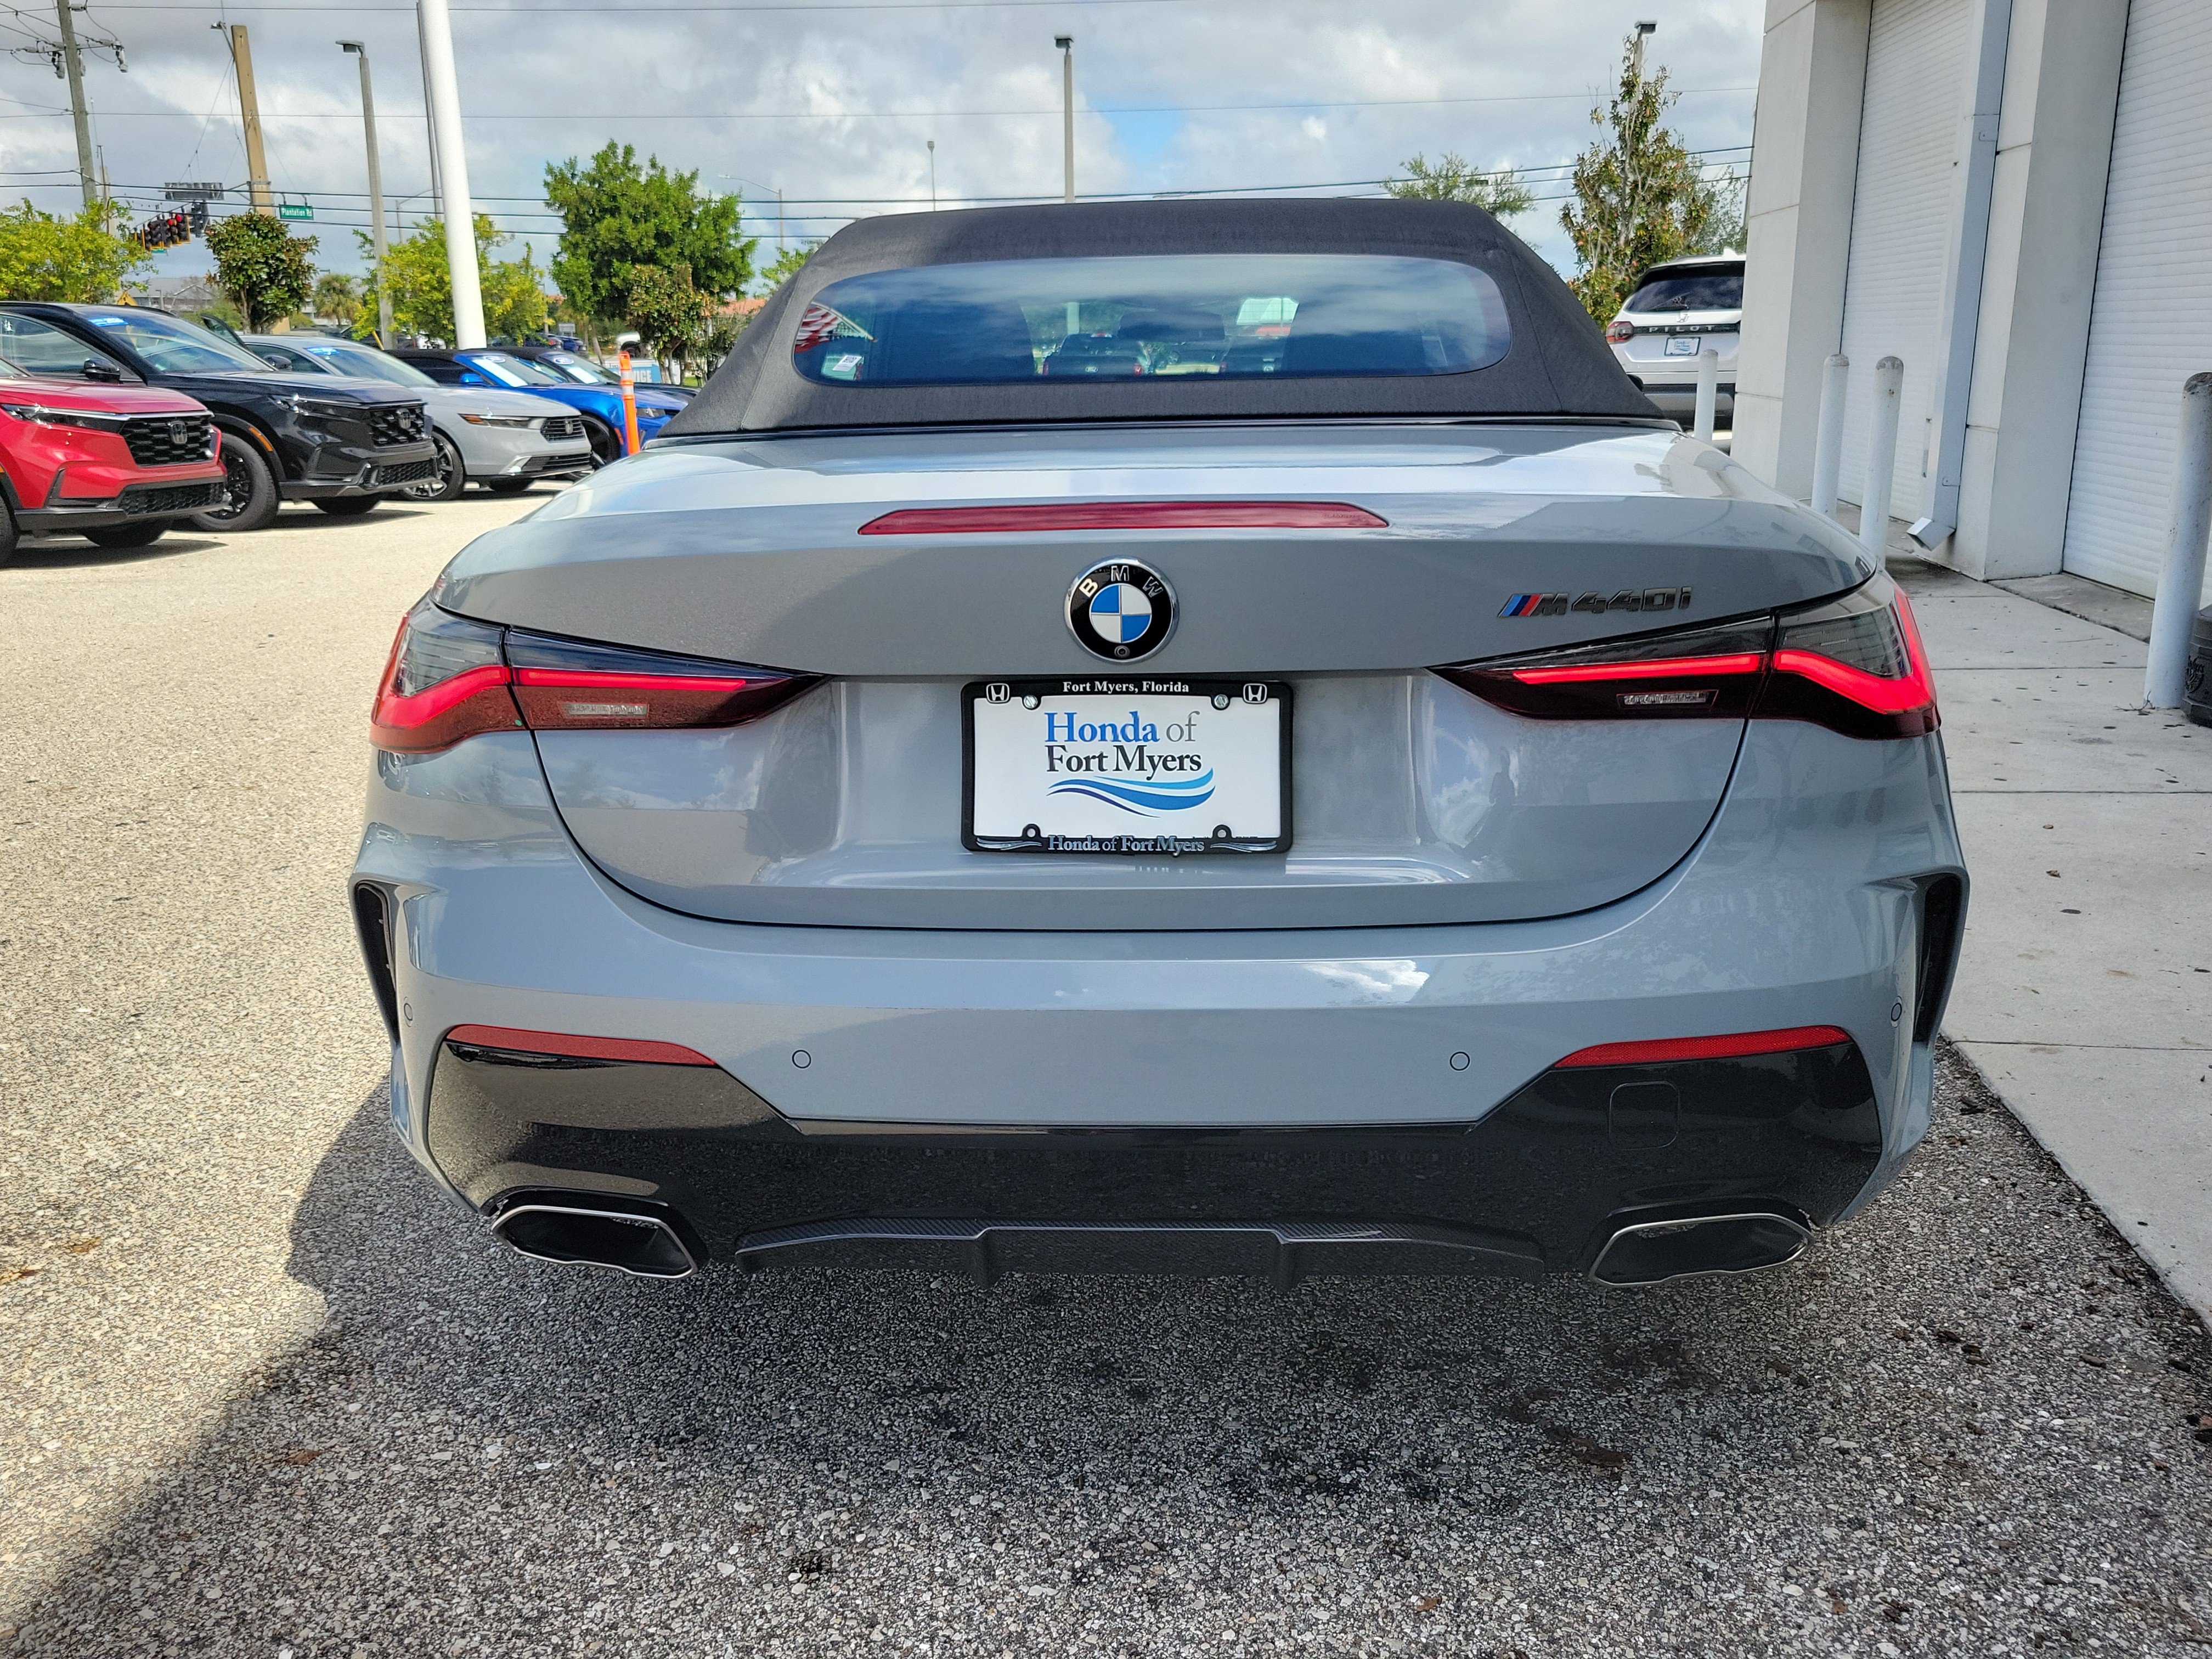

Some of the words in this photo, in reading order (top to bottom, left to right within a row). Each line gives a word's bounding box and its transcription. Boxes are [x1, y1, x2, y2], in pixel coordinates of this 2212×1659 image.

[282, 208, 306, 216] Plantation
[1079, 565, 1164, 598] BMW
[1528, 586, 1692, 617] M440i
[1063, 681, 1091, 692] Fort
[1094, 681, 1138, 694] Myers,
[1142, 681, 1189, 692] Florida
[1044, 710, 1160, 742] Honda
[1166, 710, 1200, 742] of
[1044, 744, 1109, 772] Fort
[1113, 744, 1201, 781] Myers
[1047, 835, 1100, 850] Honda
[1102, 836, 1119, 851] of
[1120, 835, 1154, 851] Fort
[1156, 836, 1205, 856] Myers
